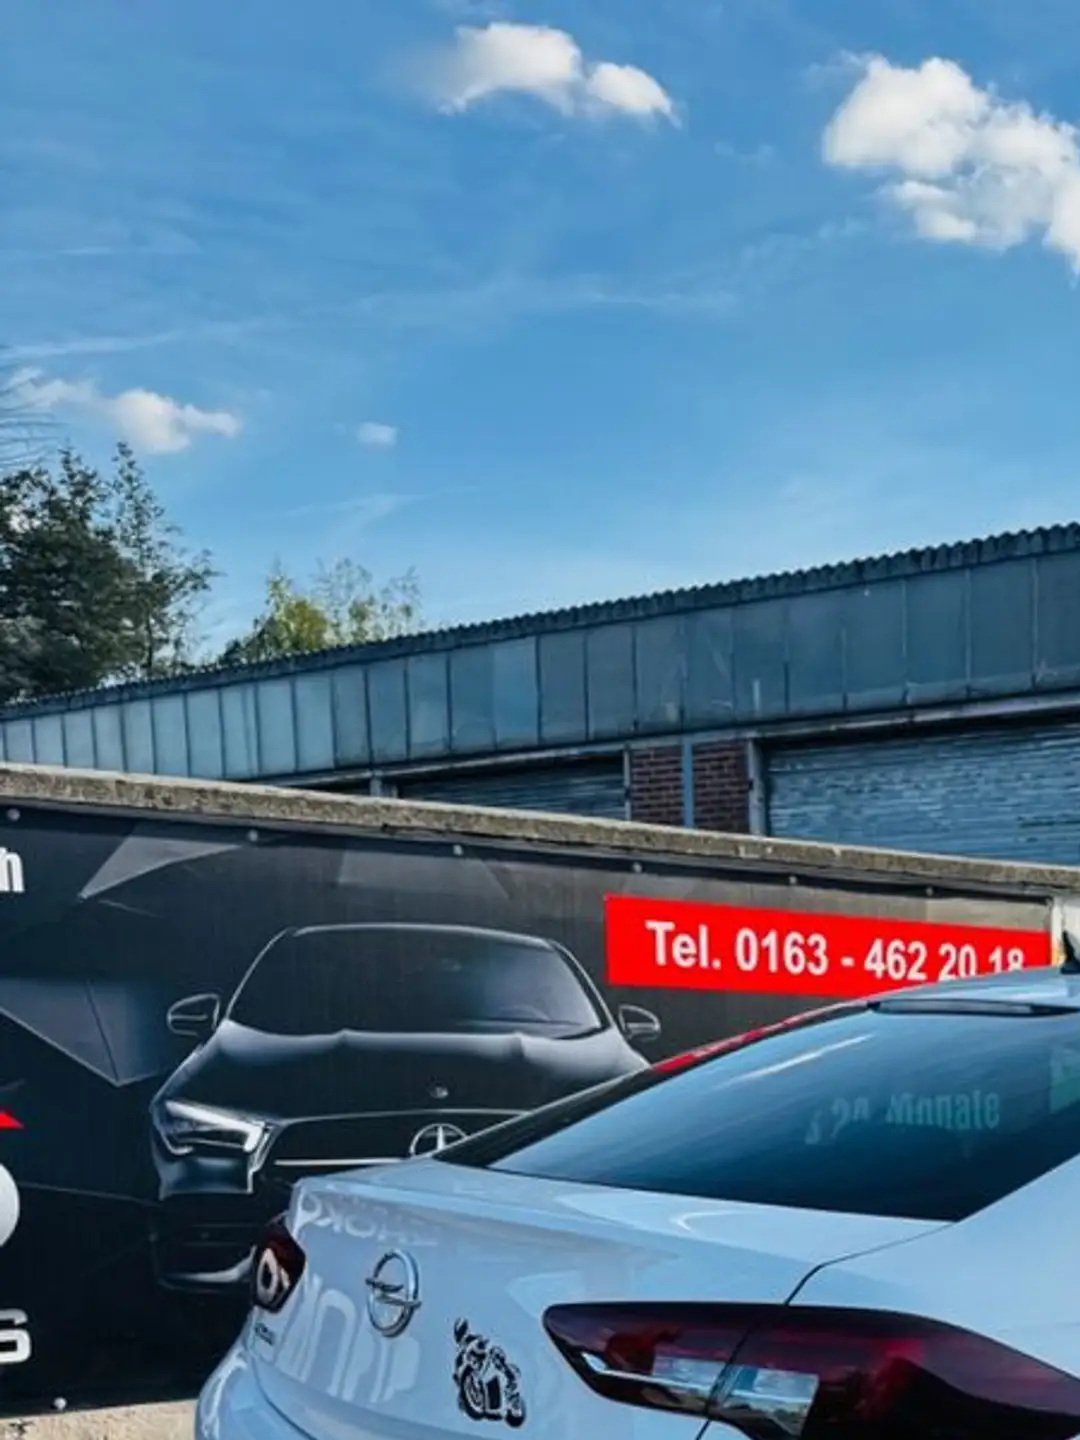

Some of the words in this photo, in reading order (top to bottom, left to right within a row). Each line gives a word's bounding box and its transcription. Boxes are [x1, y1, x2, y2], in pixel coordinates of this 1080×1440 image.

[645, 920, 721, 969] Tel.
[735, 927, 829, 976] 0163
[841, 956, 854, 967] -
[864, 938, 928, 981] 462
[939, 942, 977, 981] 20
